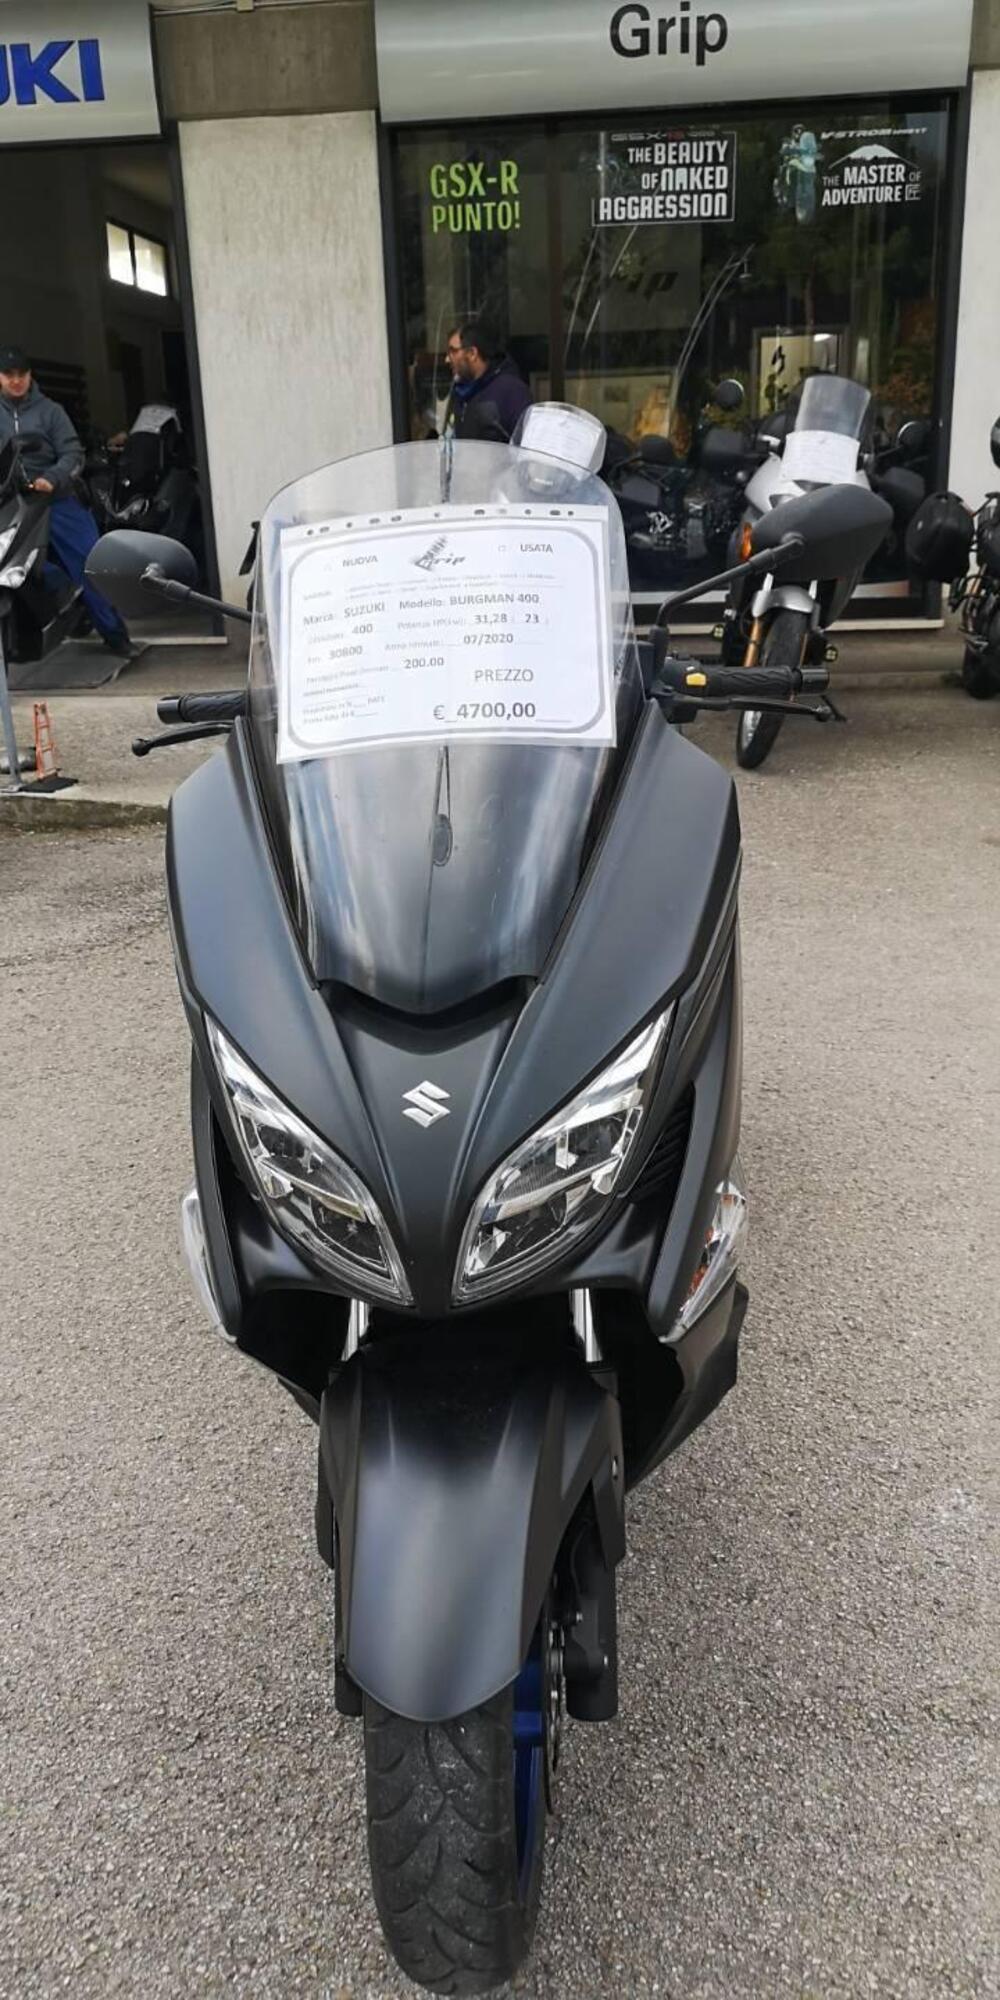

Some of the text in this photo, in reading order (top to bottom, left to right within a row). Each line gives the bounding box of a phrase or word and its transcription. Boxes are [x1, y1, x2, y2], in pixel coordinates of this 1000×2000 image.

[609, 1, 728, 66] Grip
[0, 39, 105, 106] KI
[628, 140, 728, 165] THE BEAUTY
[430, 160, 519, 199] GSX-R
[641, 166, 728, 191] OF NAKED
[822, 164, 921, 187] THE MASTER OF
[822, 185, 903, 207] ADVENTURE
[600, 193, 727, 221] AGGRESSION
[432, 201, 520, 233] PUNTO!
[520, 543, 553, 553] USATA
[342, 555, 379, 567] NUOVA
[449, 594, 514, 606] BURGMAN
[517, 593, 540, 605] 400
[344, 602, 385, 619] SUZUKI
[474, 613, 508, 626] 31,28
[525, 613, 540, 624] 23
[352, 623, 373, 635] 400
[463, 633, 514, 645] 07/2020
[404, 656, 445, 669] 200.00
[474, 668, 534, 683] PREZZO
[433, 702, 536, 721] € 4700,00
